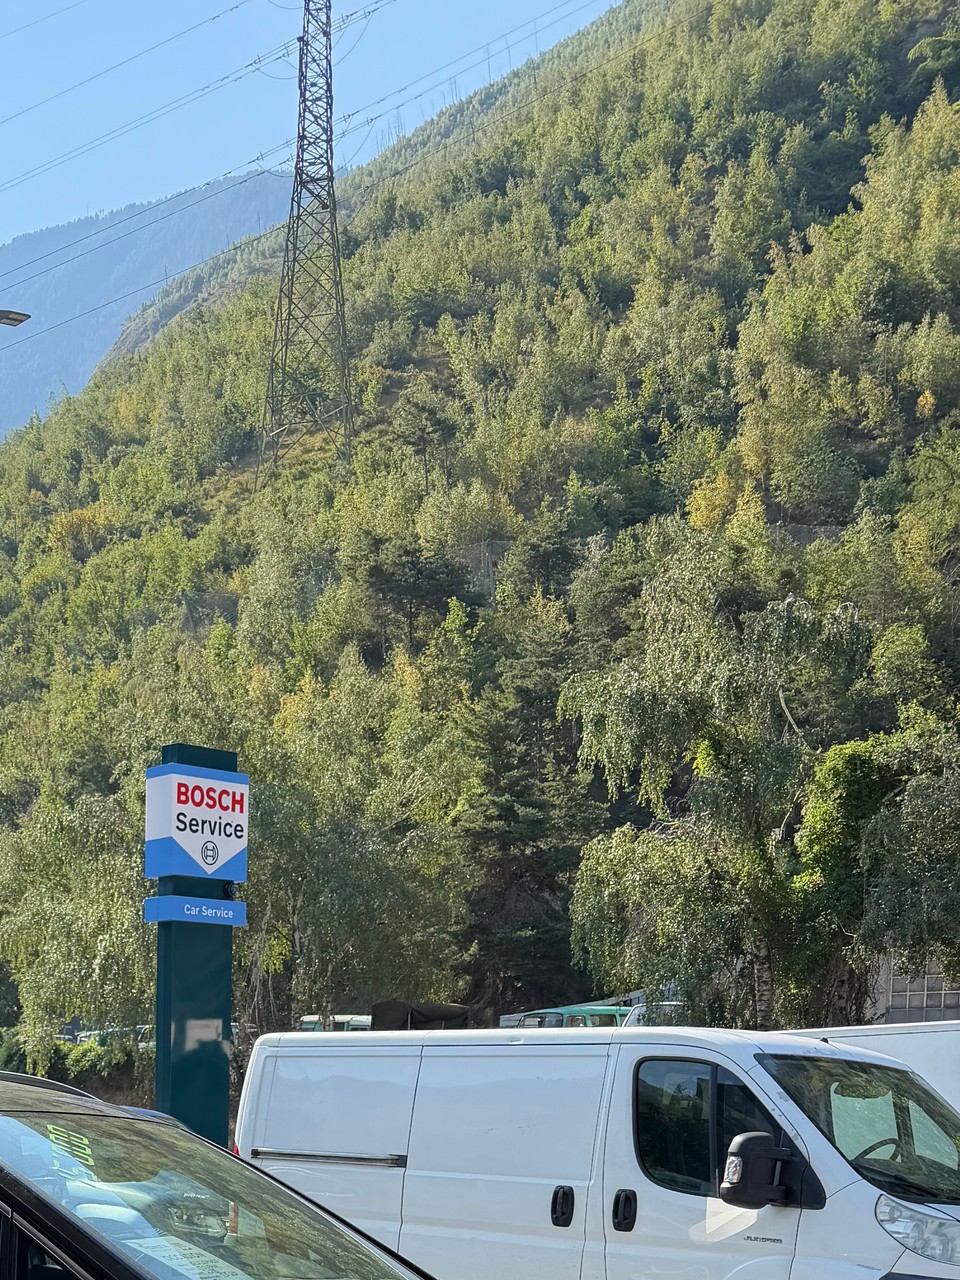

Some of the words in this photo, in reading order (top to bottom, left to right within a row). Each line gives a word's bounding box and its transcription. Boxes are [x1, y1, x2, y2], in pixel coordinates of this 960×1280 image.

[176, 782, 244, 813] BOSCH
[176, 812, 244, 839] Service
[184, 904, 200, 915] Car
[201, 905, 234, 918] Service
